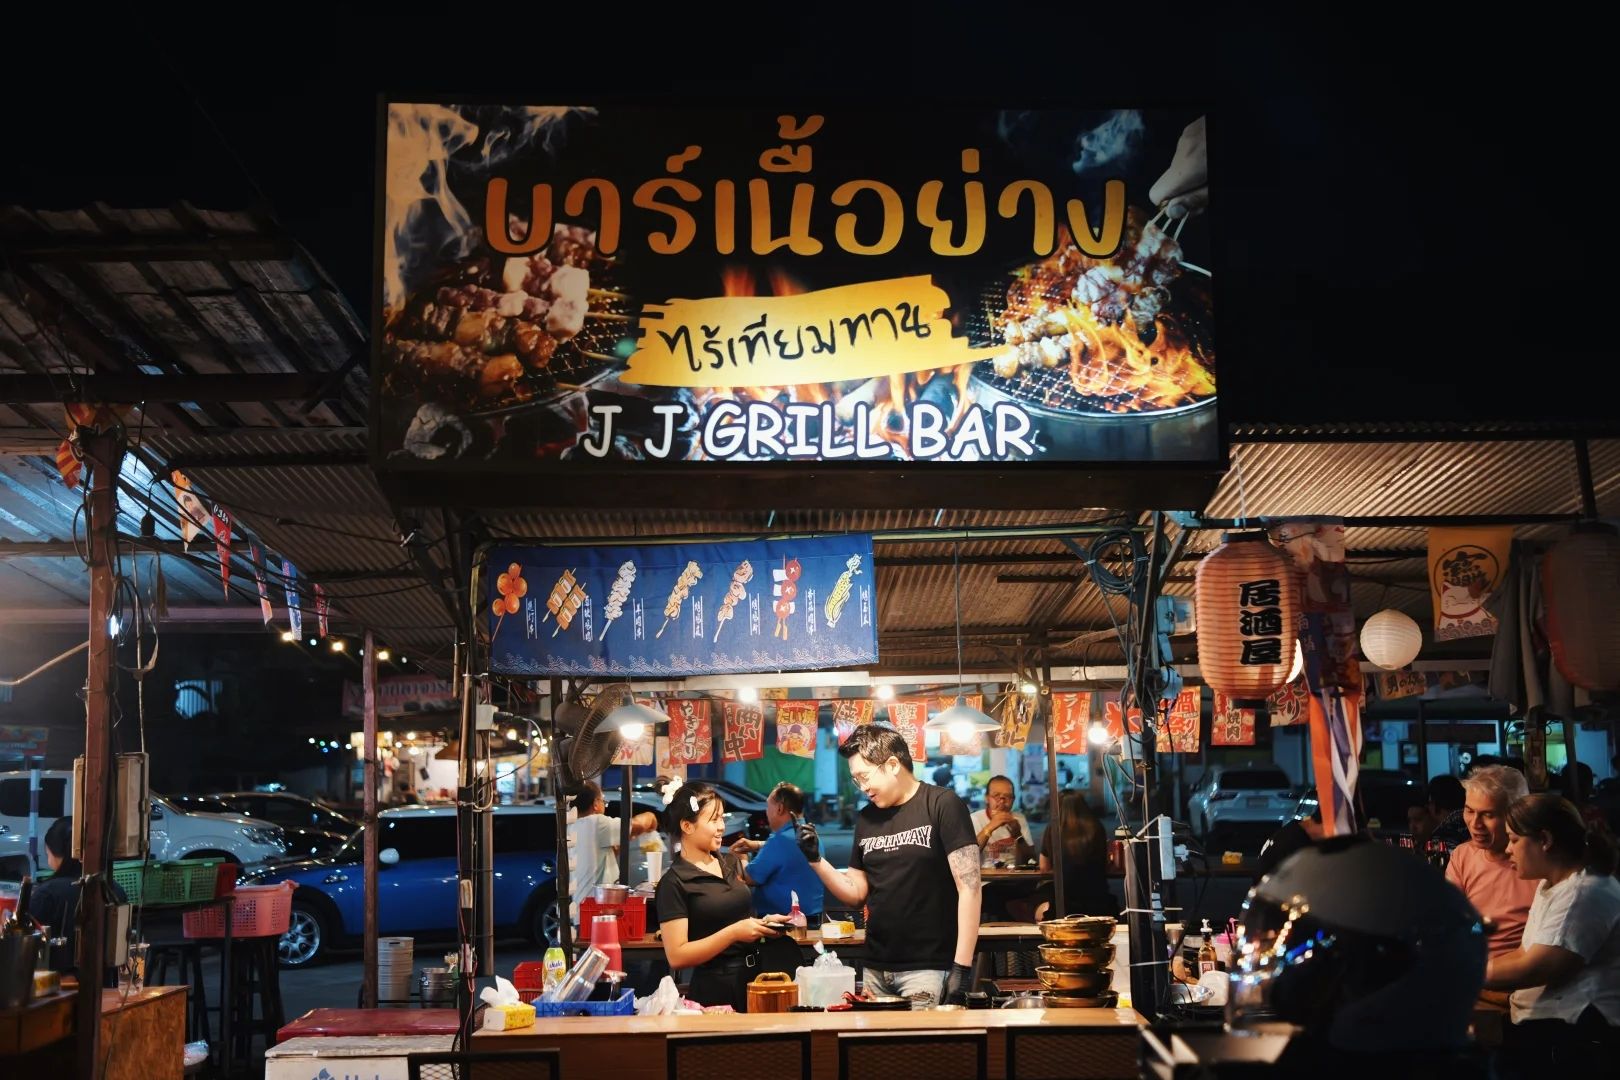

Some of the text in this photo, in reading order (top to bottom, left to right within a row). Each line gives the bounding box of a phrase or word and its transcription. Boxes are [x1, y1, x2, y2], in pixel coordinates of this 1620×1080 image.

[486, 115, 1125, 257] บาร์เนื้อย่าง
[656, 302, 931, 371] ไร้เทียมทาน
[584, 403, 1036, 458] J J GRILL BAR
[1239, 579, 1282, 666] 居酒屋
[1060, 694, 1078, 749] ラーメン
[1225, 697, 1242, 741] 焼肉
